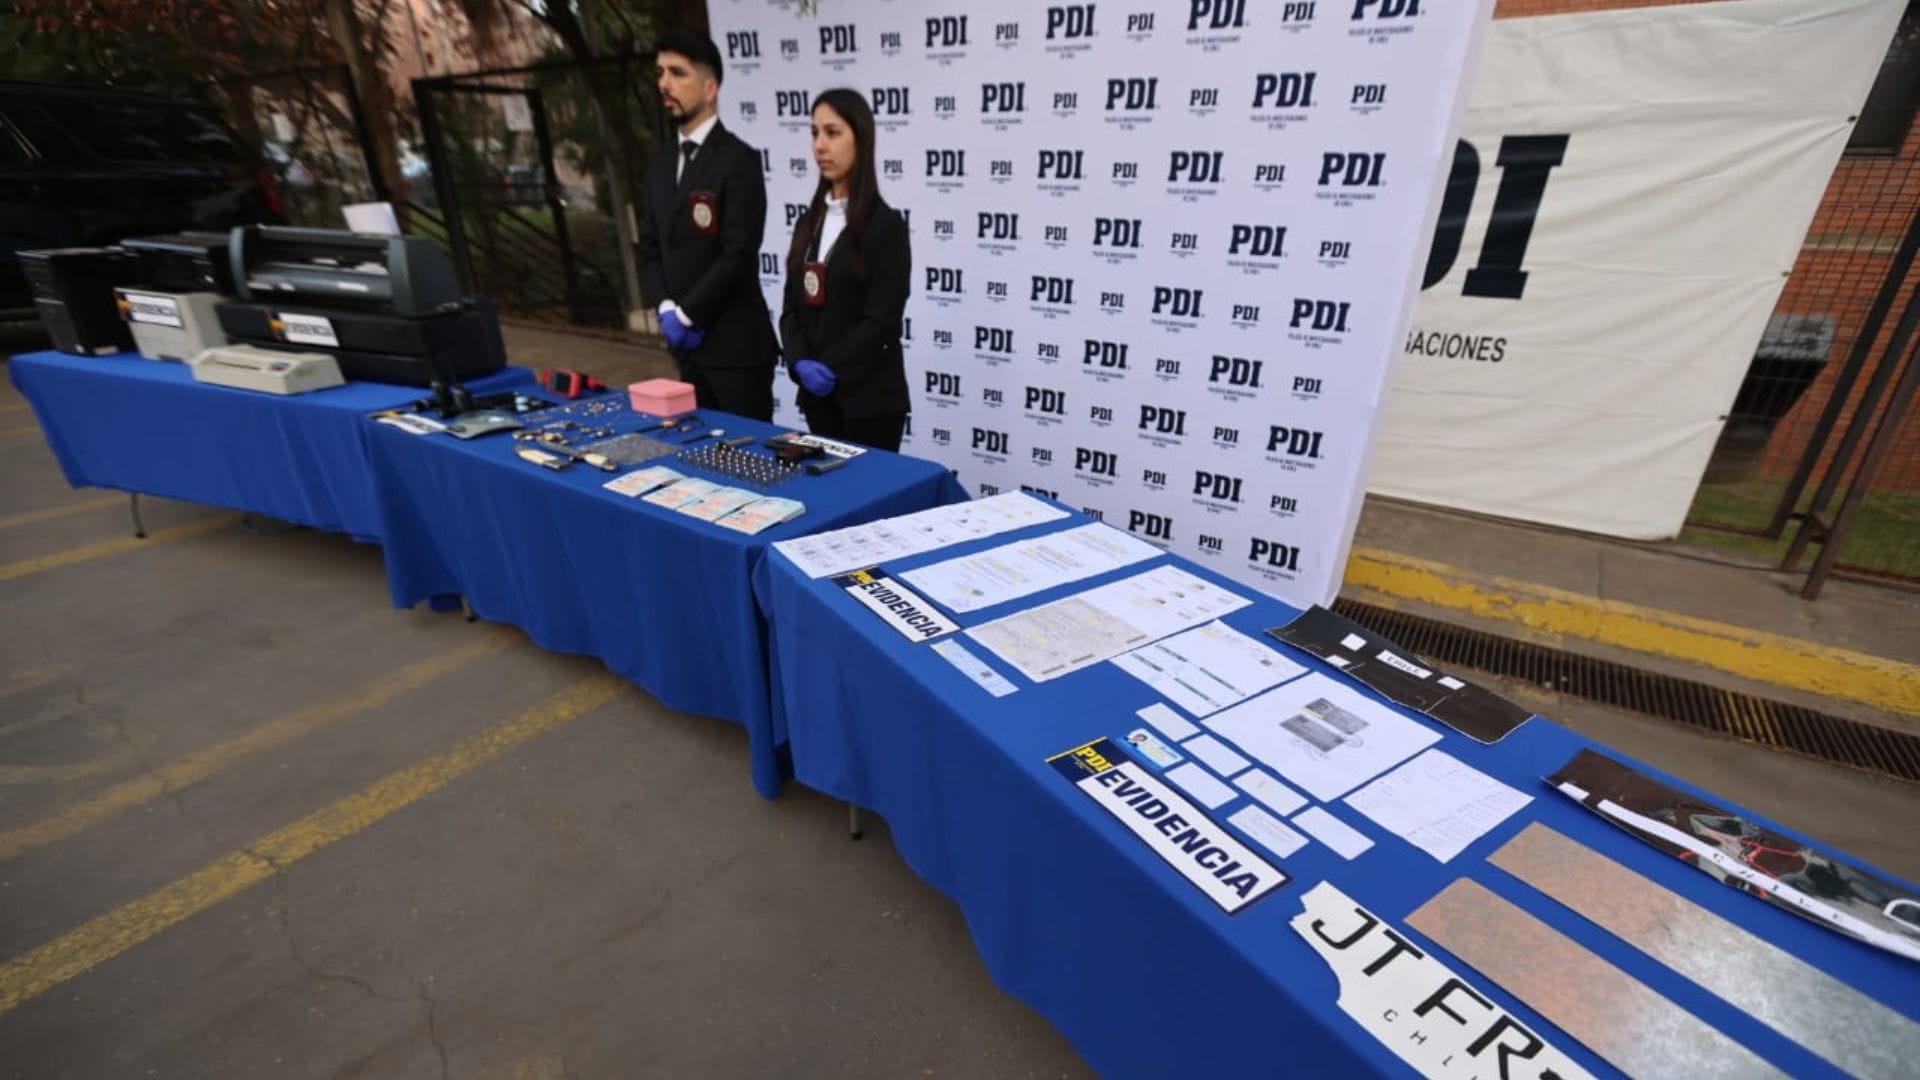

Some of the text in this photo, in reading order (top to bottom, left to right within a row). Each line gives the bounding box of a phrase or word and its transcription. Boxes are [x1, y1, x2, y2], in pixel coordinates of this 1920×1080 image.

[1046, 4, 1096, 39] PDI
[1128, 13, 1154, 31] PDI
[1188, 0, 1246, 30] PDI
[1282, 2, 1315, 21] PDI
[726, 31, 760, 58] PDI
[819, 24, 856, 54] PDI
[926, 15, 967, 47] PDI
[996, 23, 1018, 40] PDI
[776, 91, 809, 116] PDI
[872, 87, 909, 114] PDI
[981, 82, 1025, 113] PDI
[1054, 93, 1077, 108] PDI
[1106, 78, 1158, 110] PDI
[1190, 89, 1218, 106] PDI
[1252, 72, 1316, 108] PDI
[1351, 85, 1386, 103] PDI
[926, 150, 964, 176] PDI
[991, 161, 1012, 175] PDI
[1038, 150, 1083, 179] PDI
[1113, 163, 1137, 178] PDI
[1168, 151, 1223, 182] PDI
[1255, 165, 1285, 181] PDI
[1318, 152, 1386, 184] PDI
[978, 212, 1018, 240] PDI
[1045, 226, 1067, 241] PDI
[1093, 218, 1141, 248] PDI
[1171, 233, 1197, 249] PDI
[1229, 224, 1287, 257] PDI
[1319, 241, 1350, 258] PDI
[761, 253, 779, 275] DI
[926, 267, 962, 293] PDI
[987, 282, 1007, 296] PDI
[1031, 276, 1073, 304] PDI
[1101, 292, 1123, 307] PDI
[1152, 286, 1203, 317] PDI
[1232, 305, 1259, 321] PDI
[1290, 298, 1350, 332] PDI
[974, 326, 1013, 353] PDI
[1038, 343, 1059, 358] PDI
[1405, 331, 1507, 363] ACIONES
[1083, 339, 1128, 369] PDI
[1156, 359, 1180, 374] PDI
[926, 371, 960, 397] PDI
[1209, 355, 1262, 388] PDI
[1293, 377, 1322, 393] PDI
[1025, 386, 1065, 415] PDI
[1091, 406, 1112, 421] PDI
[1139, 405, 1186, 436] PDI
[972, 427, 1008, 454] PDI
[1213, 427, 1239, 443] PDI
[1267, 425, 1323, 458] PDI
[1032, 447, 1052, 461] PDI
[1075, 447, 1117, 477] PDI
[1143, 470, 1166, 485] PDI
[1193, 471, 1243, 503] PDI
[1270, 495, 1297, 512] PDI
[1128, 510, 1172, 540] PDI
[1198, 535, 1222, 551] PDI
[1249, 537, 1300, 571] PDI
[860, 580, 943, 637] EVIDENCIA
[1076, 746, 1113, 773] PDI
[1095, 768, 1260, 899] EVIDENCIA
[1311, 907, 1425, 977] JT
